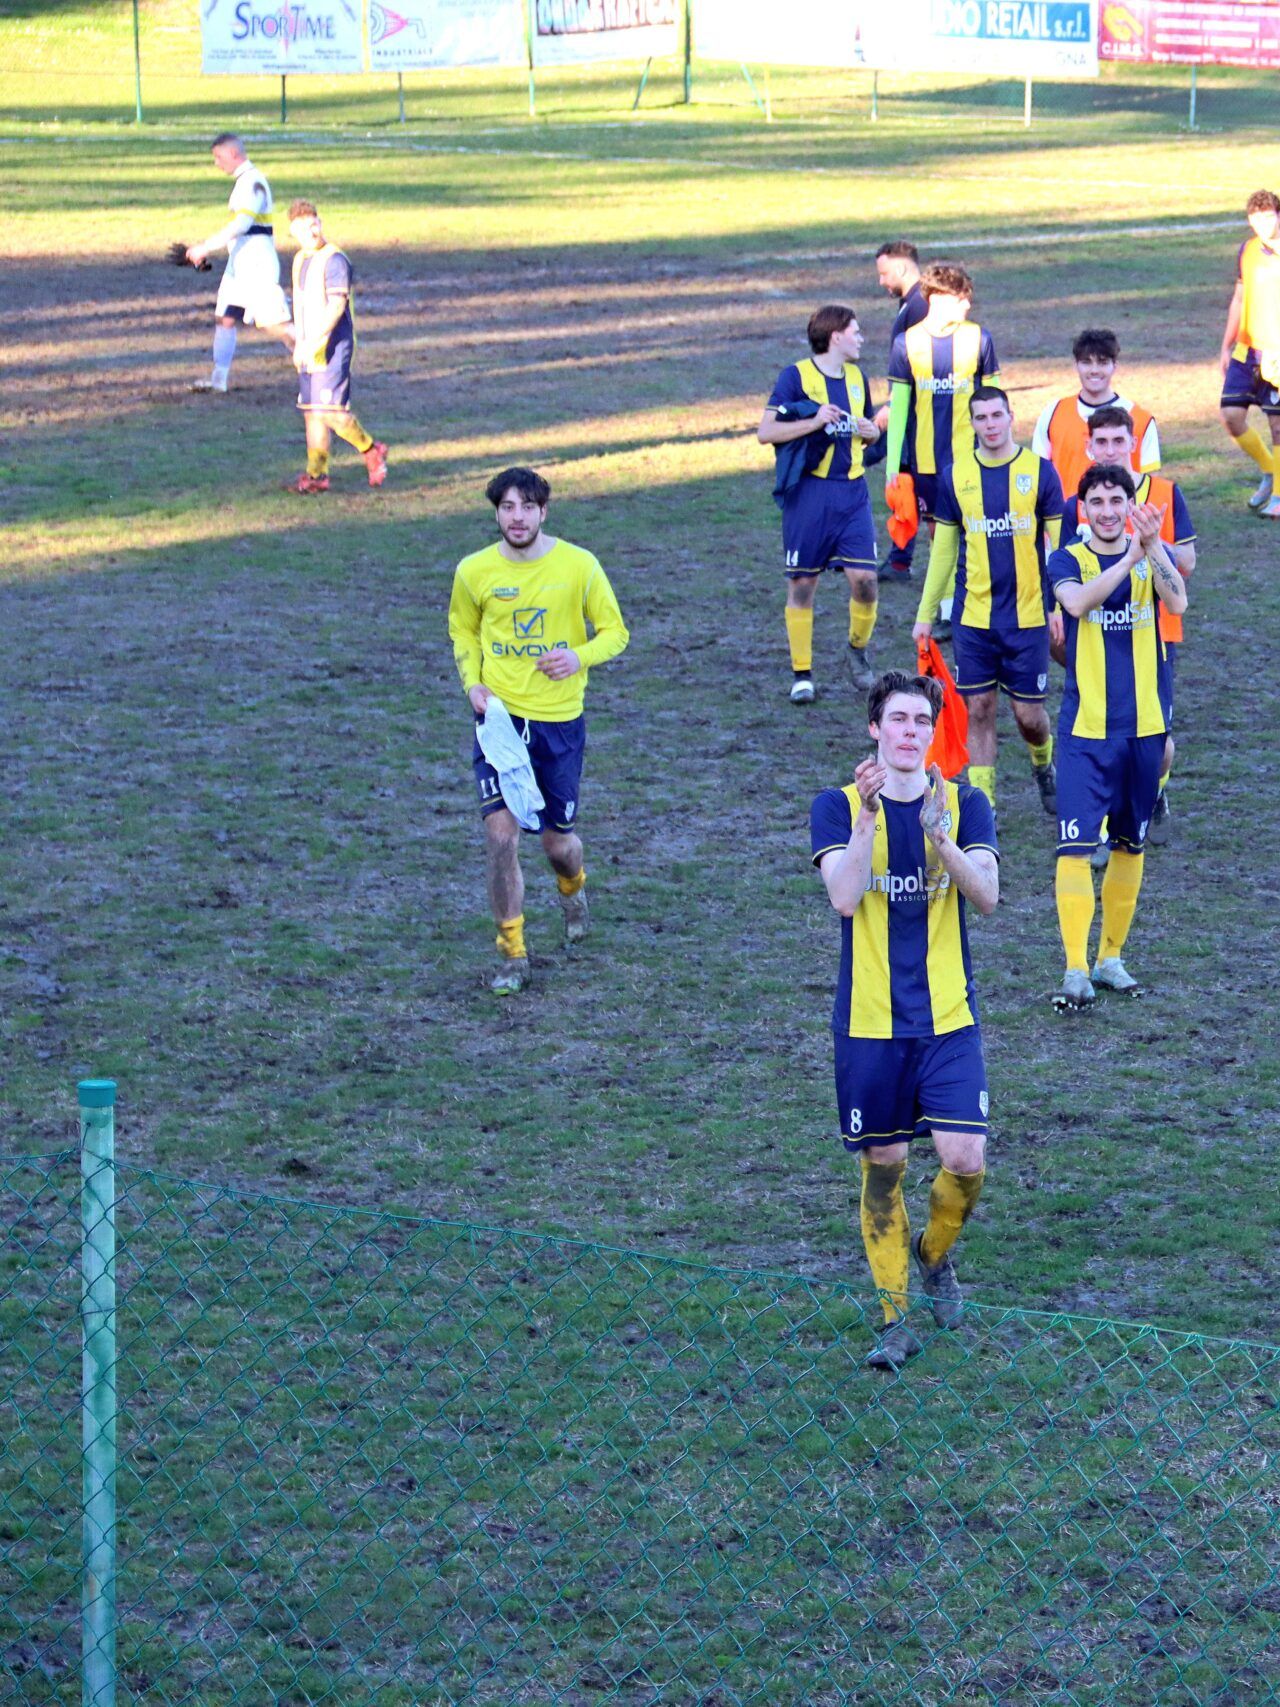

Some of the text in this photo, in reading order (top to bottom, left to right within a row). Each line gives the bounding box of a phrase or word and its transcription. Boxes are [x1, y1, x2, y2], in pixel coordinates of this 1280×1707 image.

[986, 3, 1051, 38] RETAIL
[1053, 10, 1087, 39] s.r.l.
[966, 511, 1032, 538] UnipolSai
[786, 549, 800, 568] 14
[479, 777, 499, 799] 11
[1060, 818, 1080, 841] 16
[850, 1108, 863, 1134] 8
